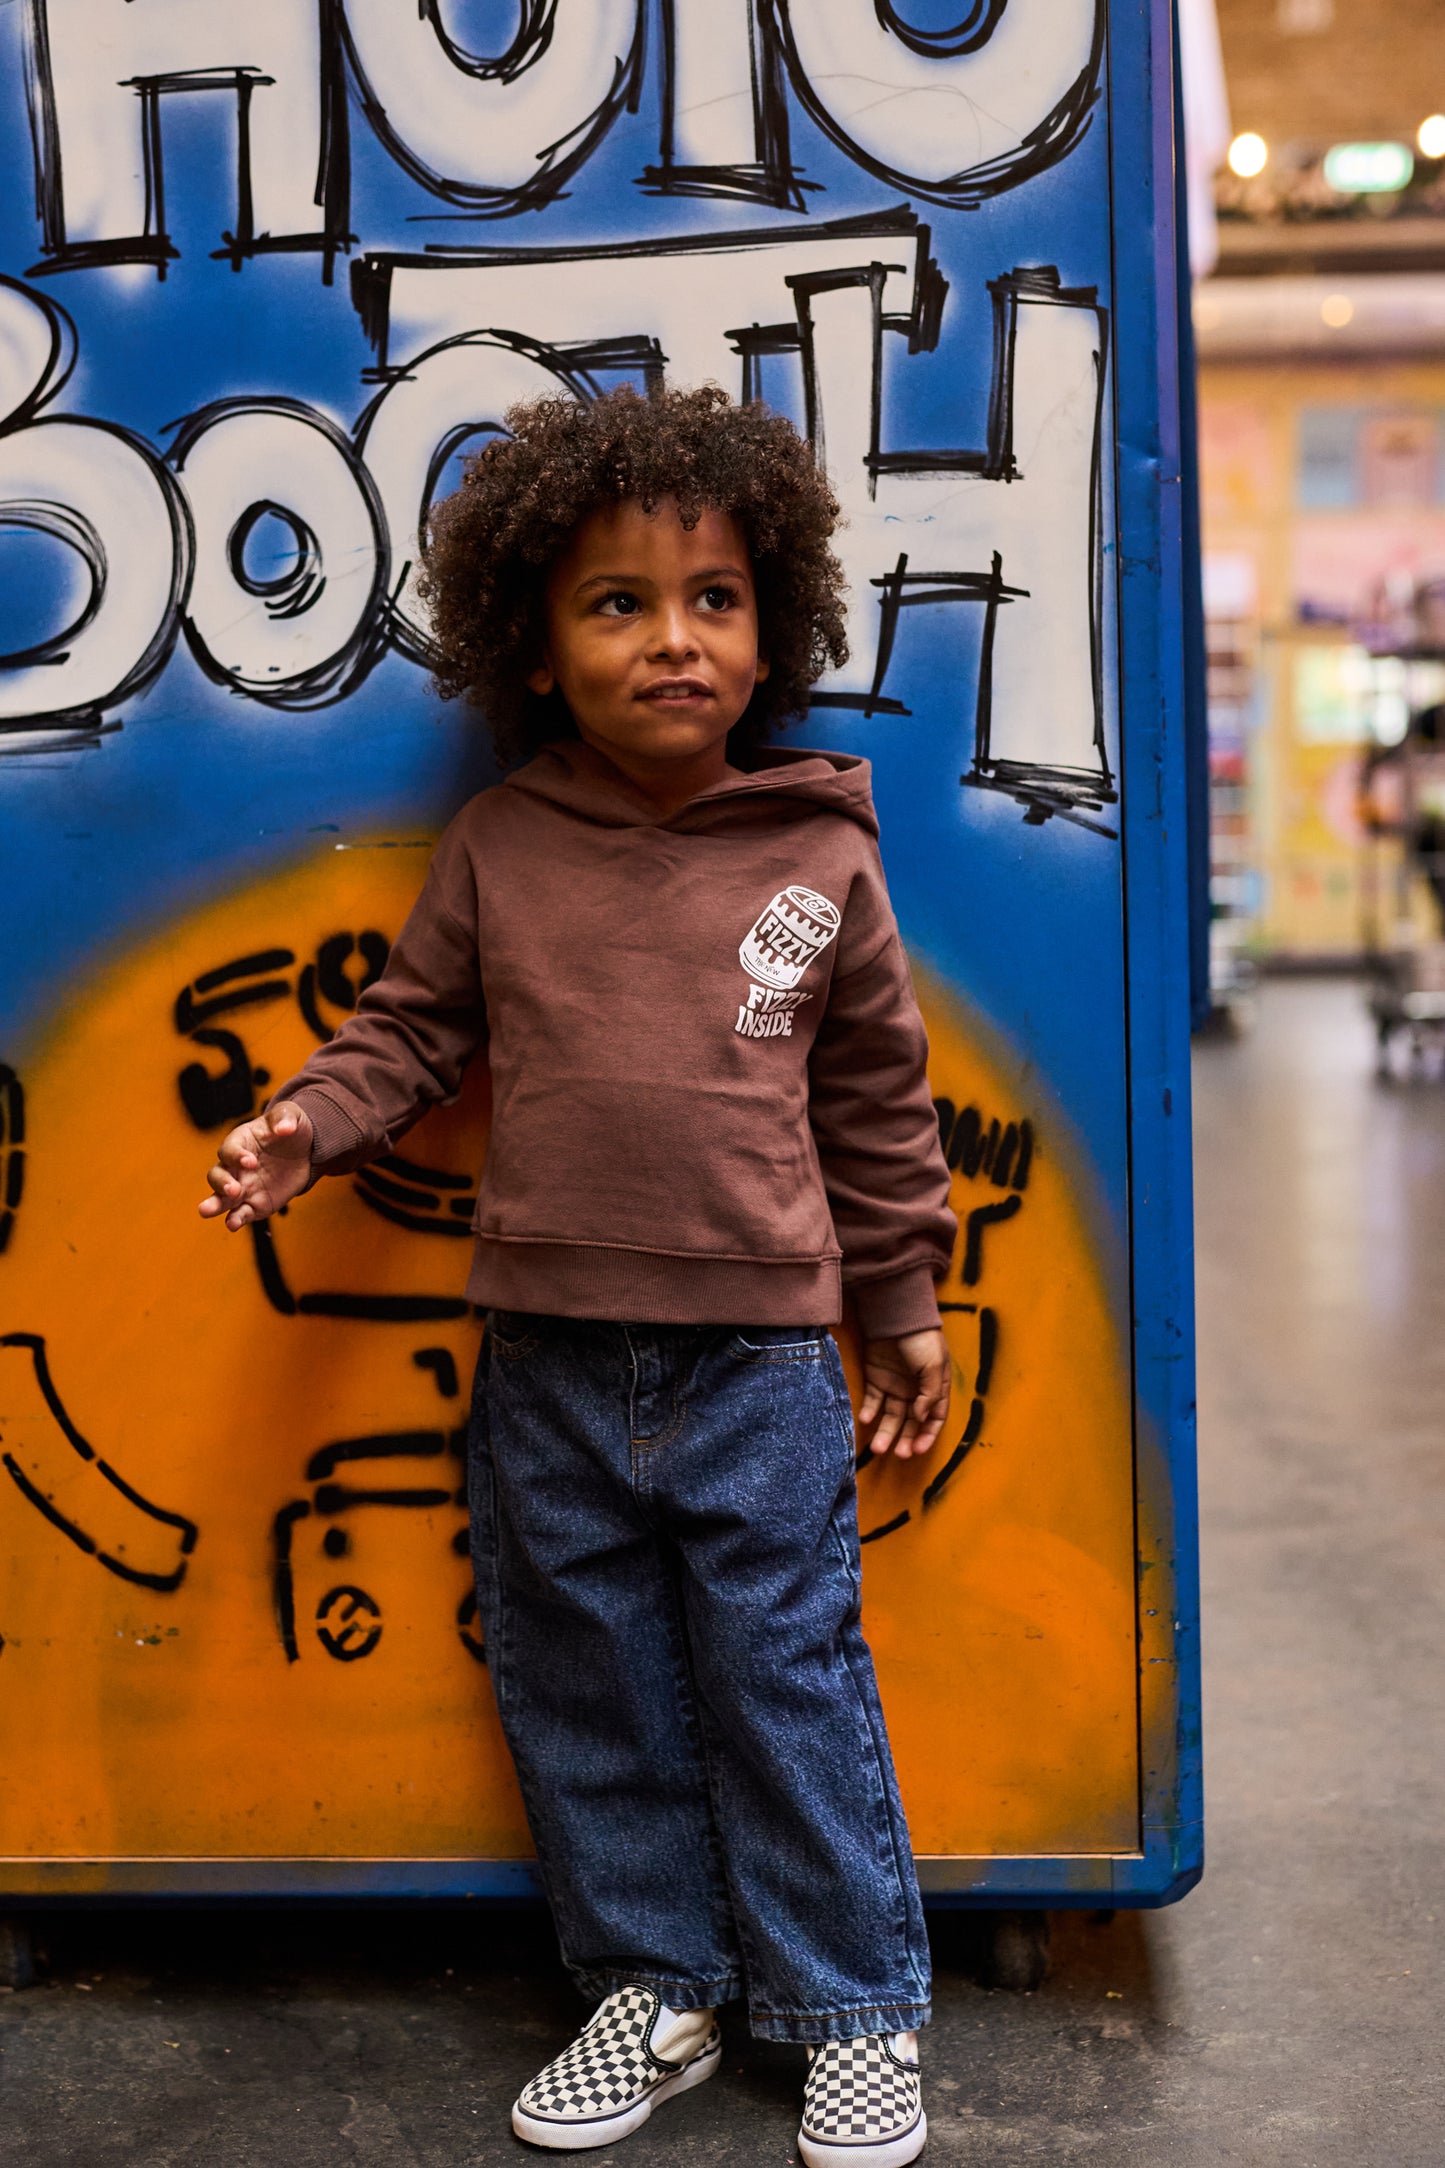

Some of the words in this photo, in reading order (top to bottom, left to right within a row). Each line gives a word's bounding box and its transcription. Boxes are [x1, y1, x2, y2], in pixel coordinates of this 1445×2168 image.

[760, 914, 816, 963] FIZZY
[747, 984, 813, 1013] FIZZY
[735, 1006, 794, 1037] INSIDE
